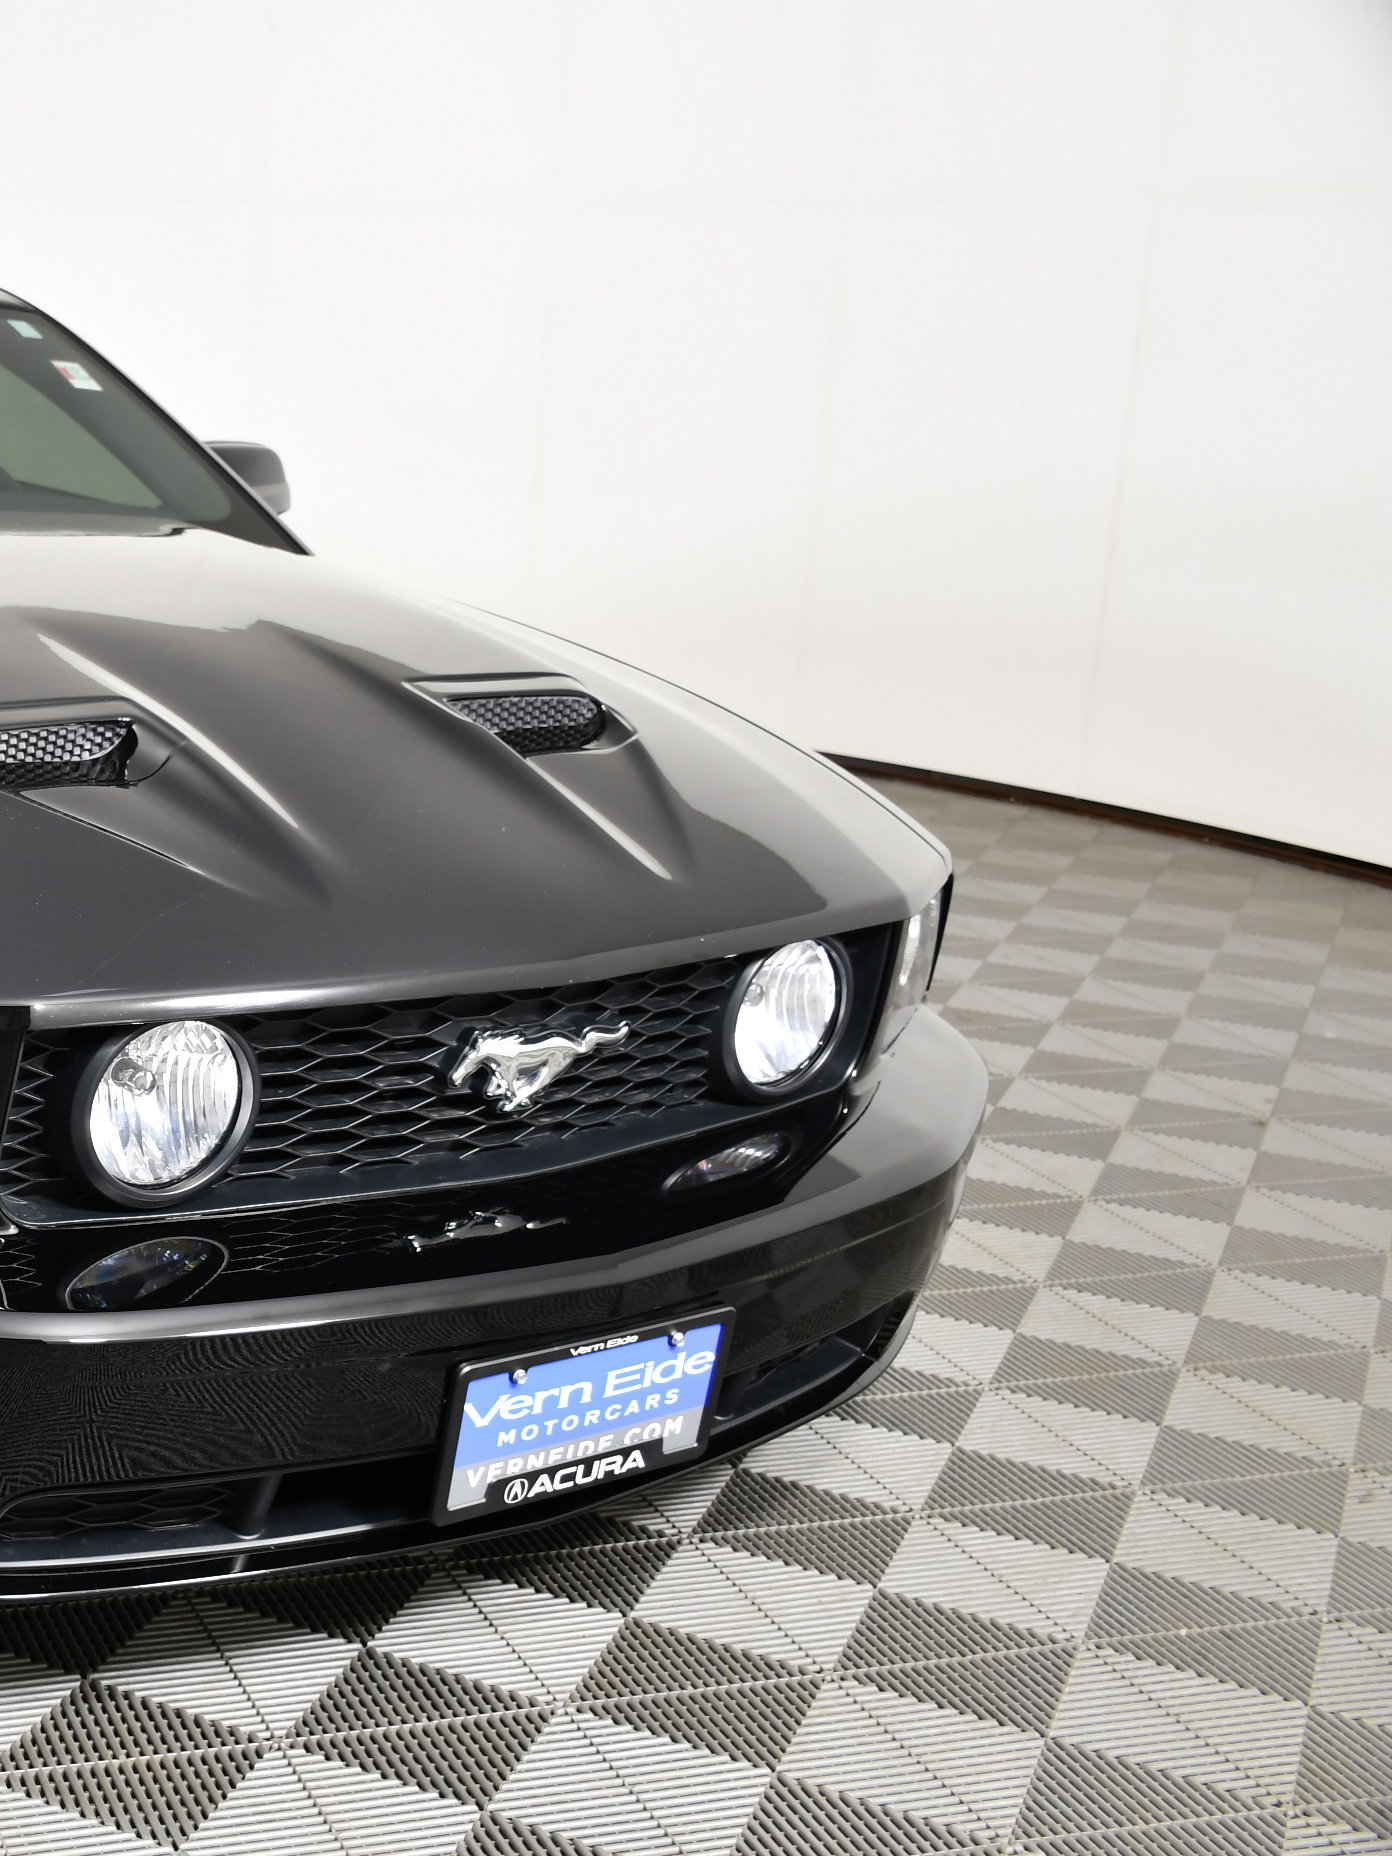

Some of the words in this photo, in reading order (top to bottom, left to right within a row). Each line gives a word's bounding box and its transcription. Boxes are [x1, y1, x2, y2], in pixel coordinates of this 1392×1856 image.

[570, 1342, 604, 1356] Vern
[606, 1335, 639, 1348] Eide
[464, 1381, 593, 1428] Vern
[602, 1350, 716, 1398] Eide
[497, 1388, 680, 1447] MOTORCARS
[527, 1449, 646, 1498] ACURA
